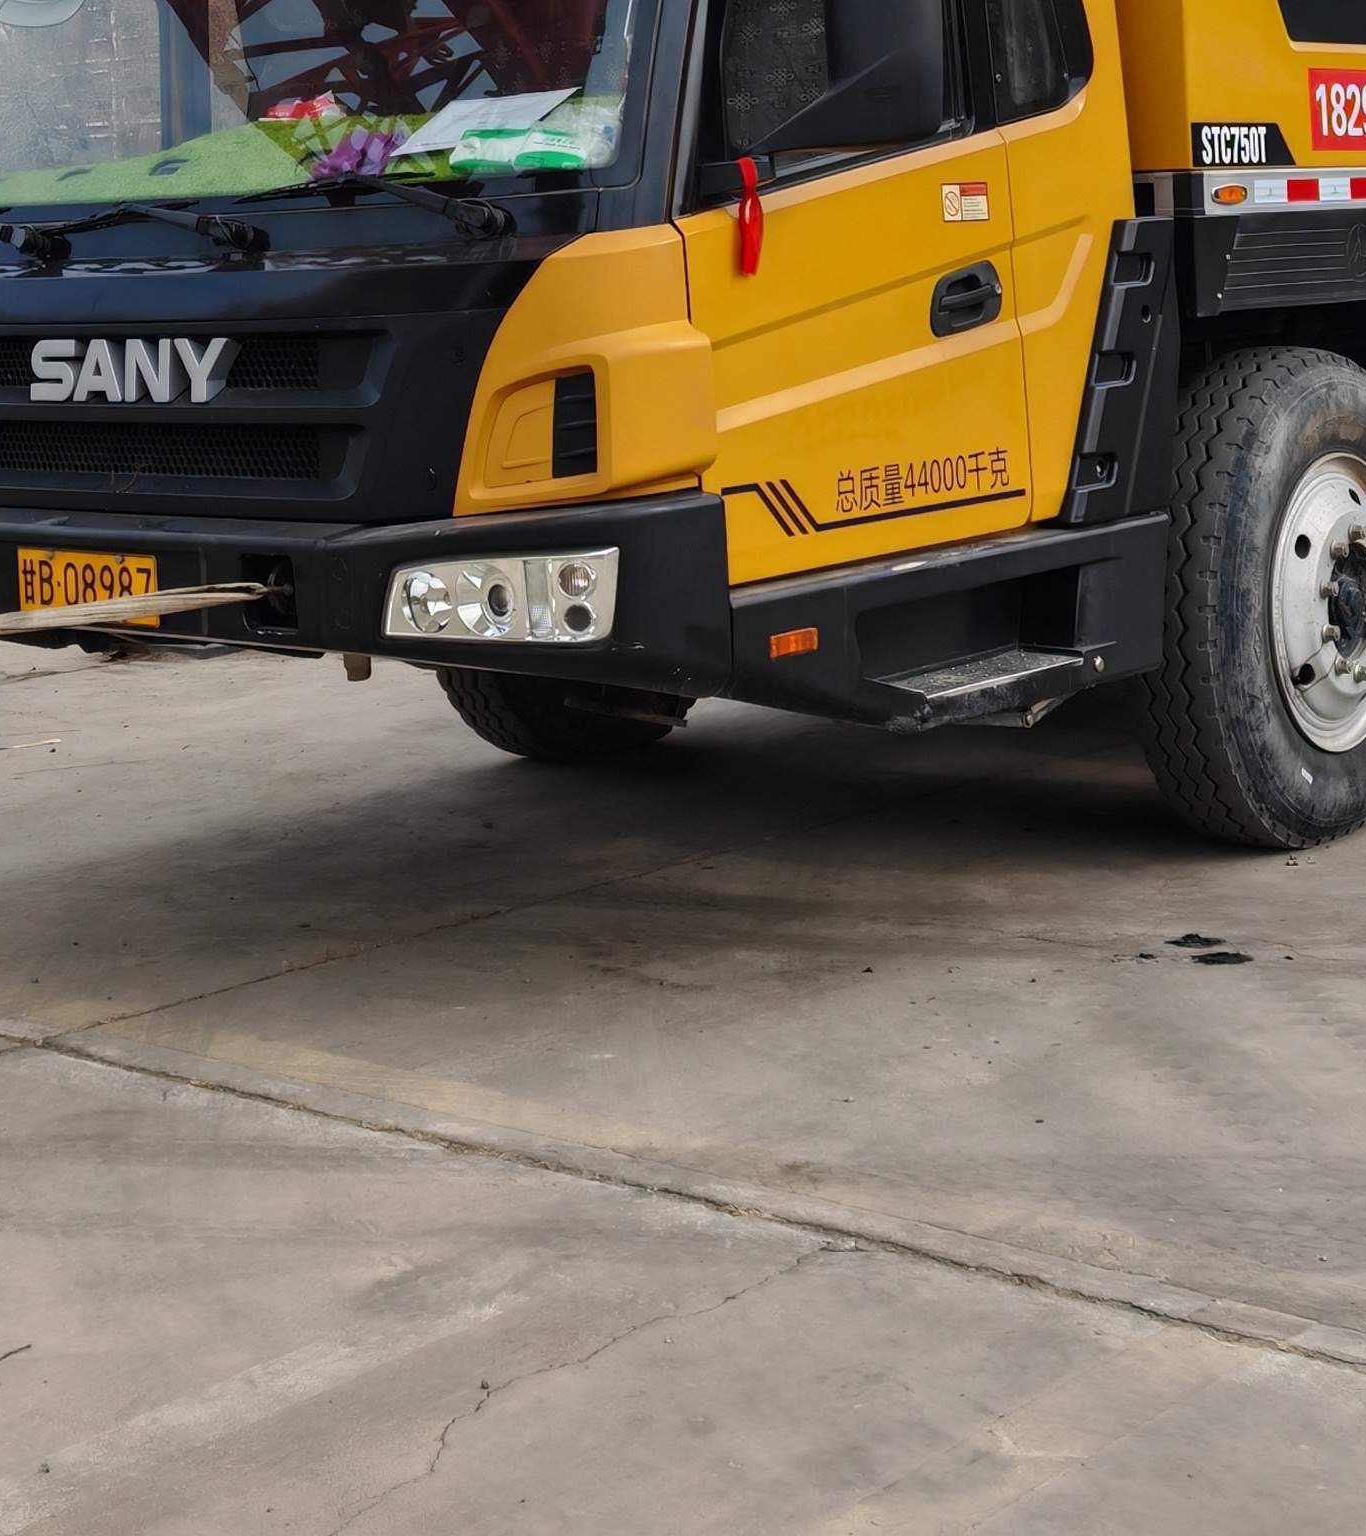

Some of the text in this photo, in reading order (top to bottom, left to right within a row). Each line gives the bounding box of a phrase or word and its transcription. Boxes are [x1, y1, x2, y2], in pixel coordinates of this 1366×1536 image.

[1201, 125, 1267, 165] STC750T
[30, 337, 241, 403] SANY
[836, 446, 1010, 513] 总质量44000千克
